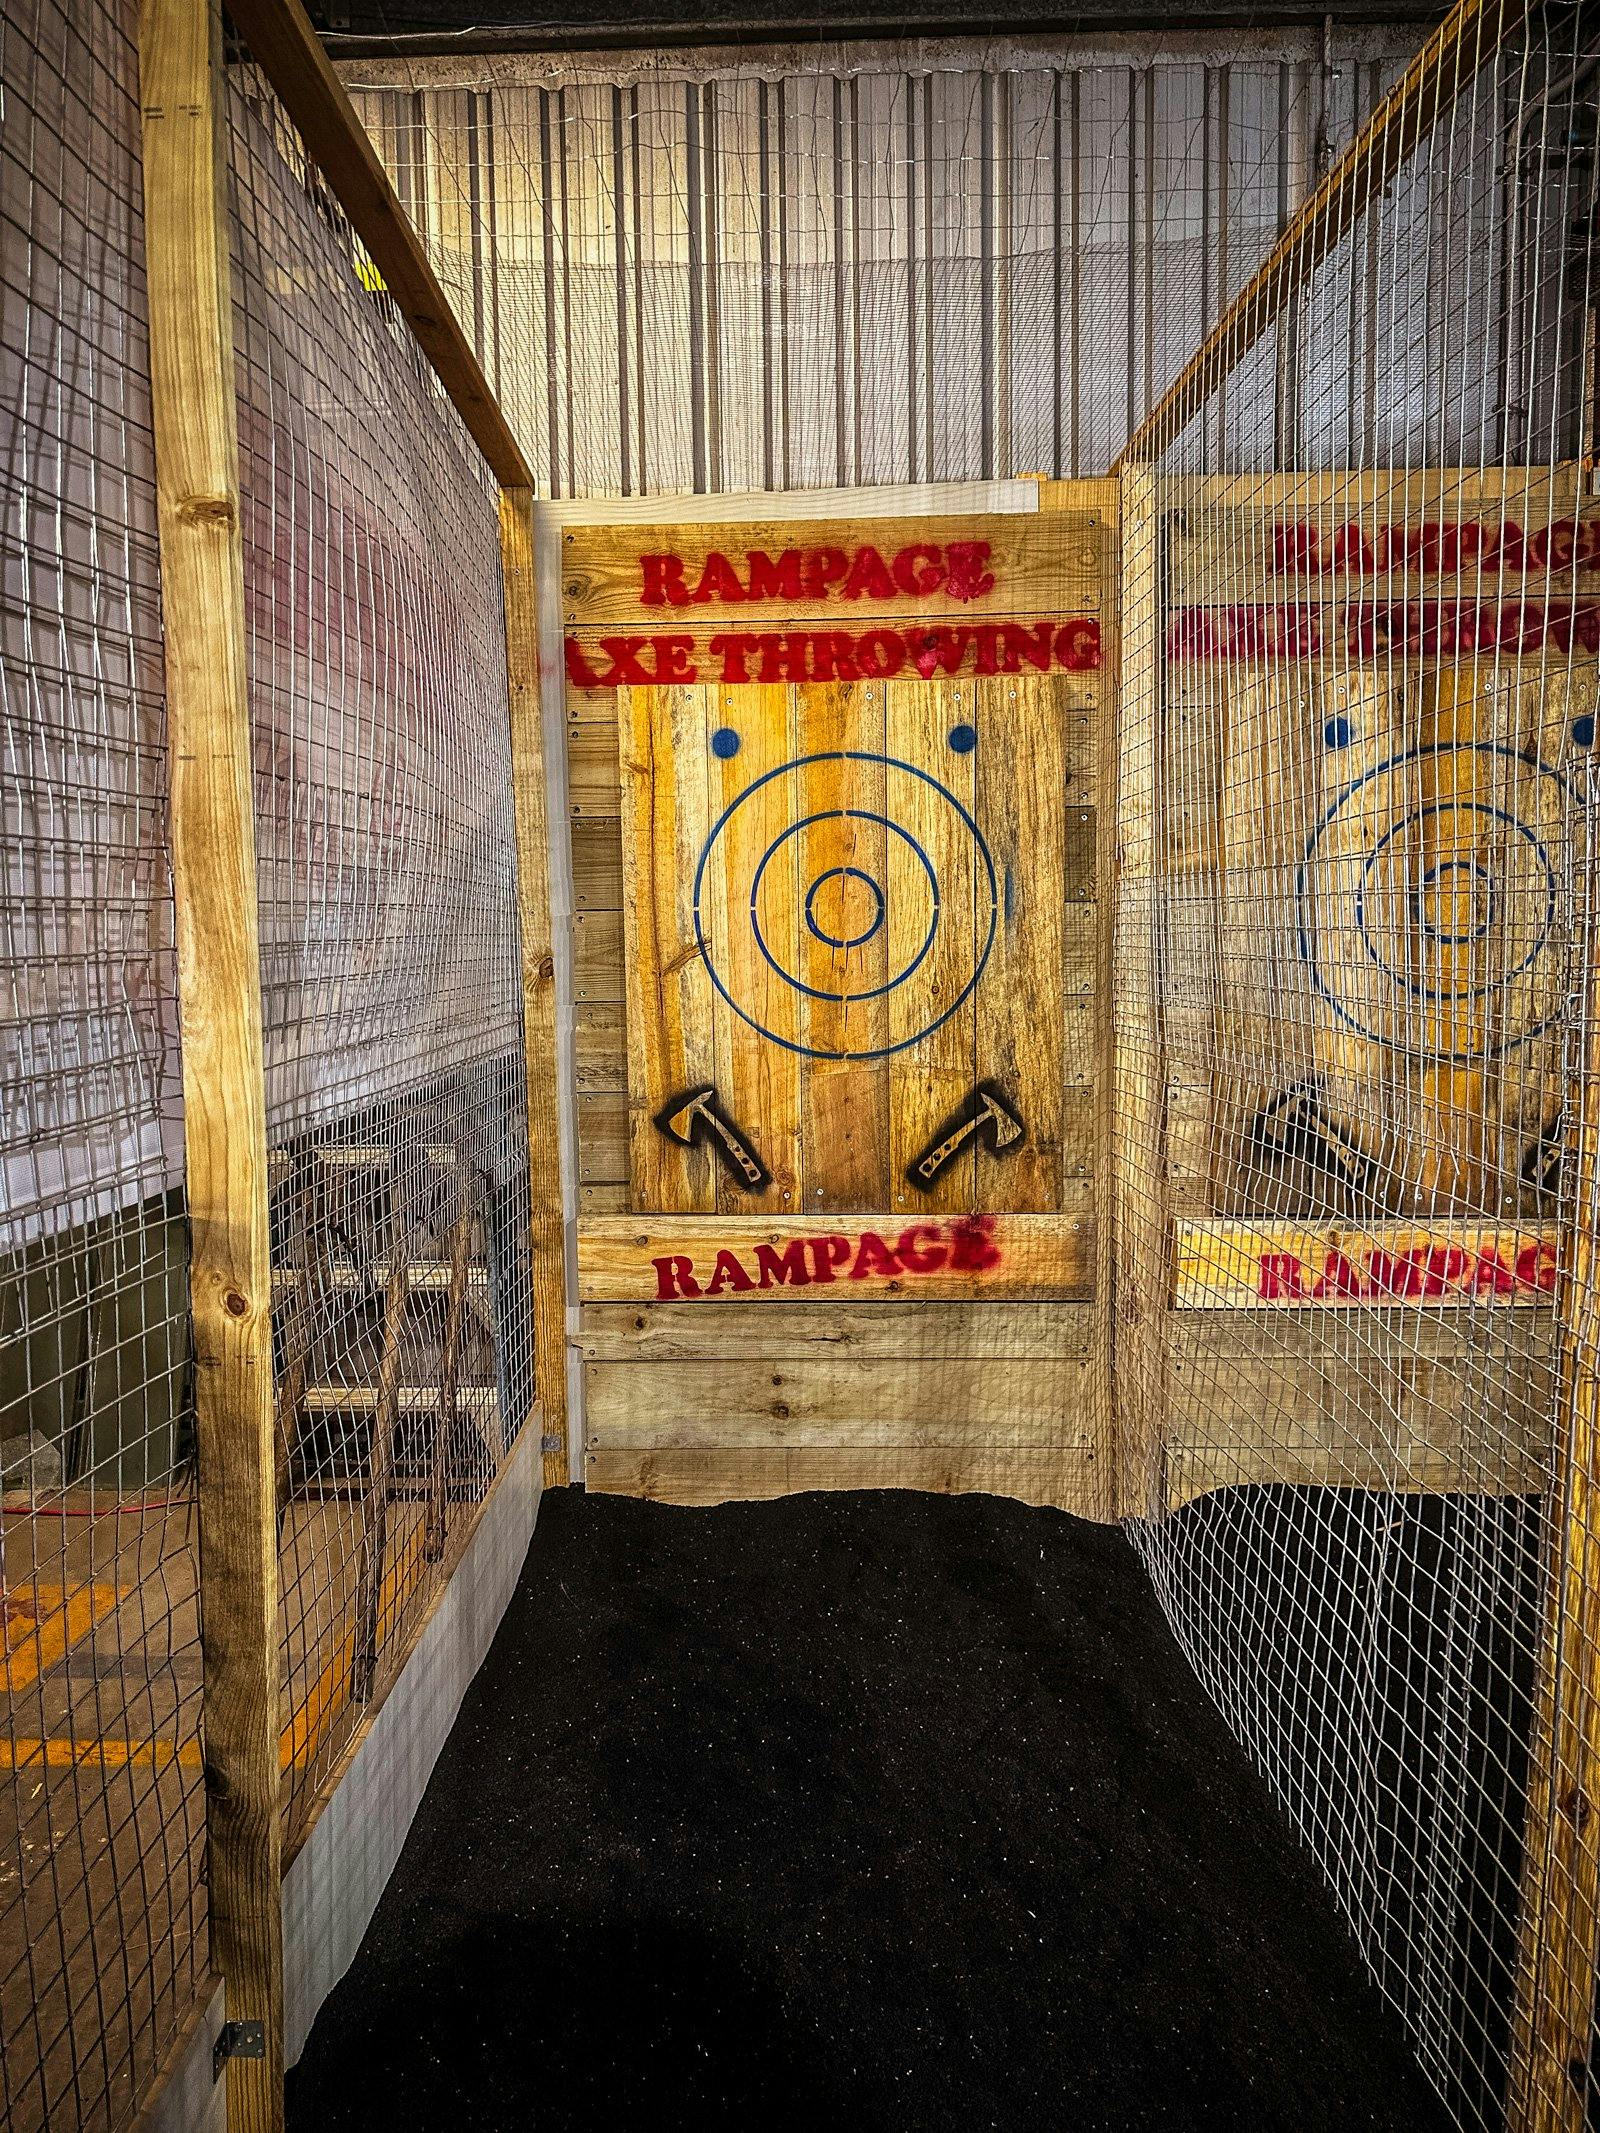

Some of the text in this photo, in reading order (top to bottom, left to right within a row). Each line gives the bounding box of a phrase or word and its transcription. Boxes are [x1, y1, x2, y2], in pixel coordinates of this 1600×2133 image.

[639, 541, 995, 605] RAMPAGE
[1270, 520, 1600, 575] RAMPAG
[709, 620, 1101, 683] THROWING
[652, 1213, 1002, 1300] RAMPAGE
